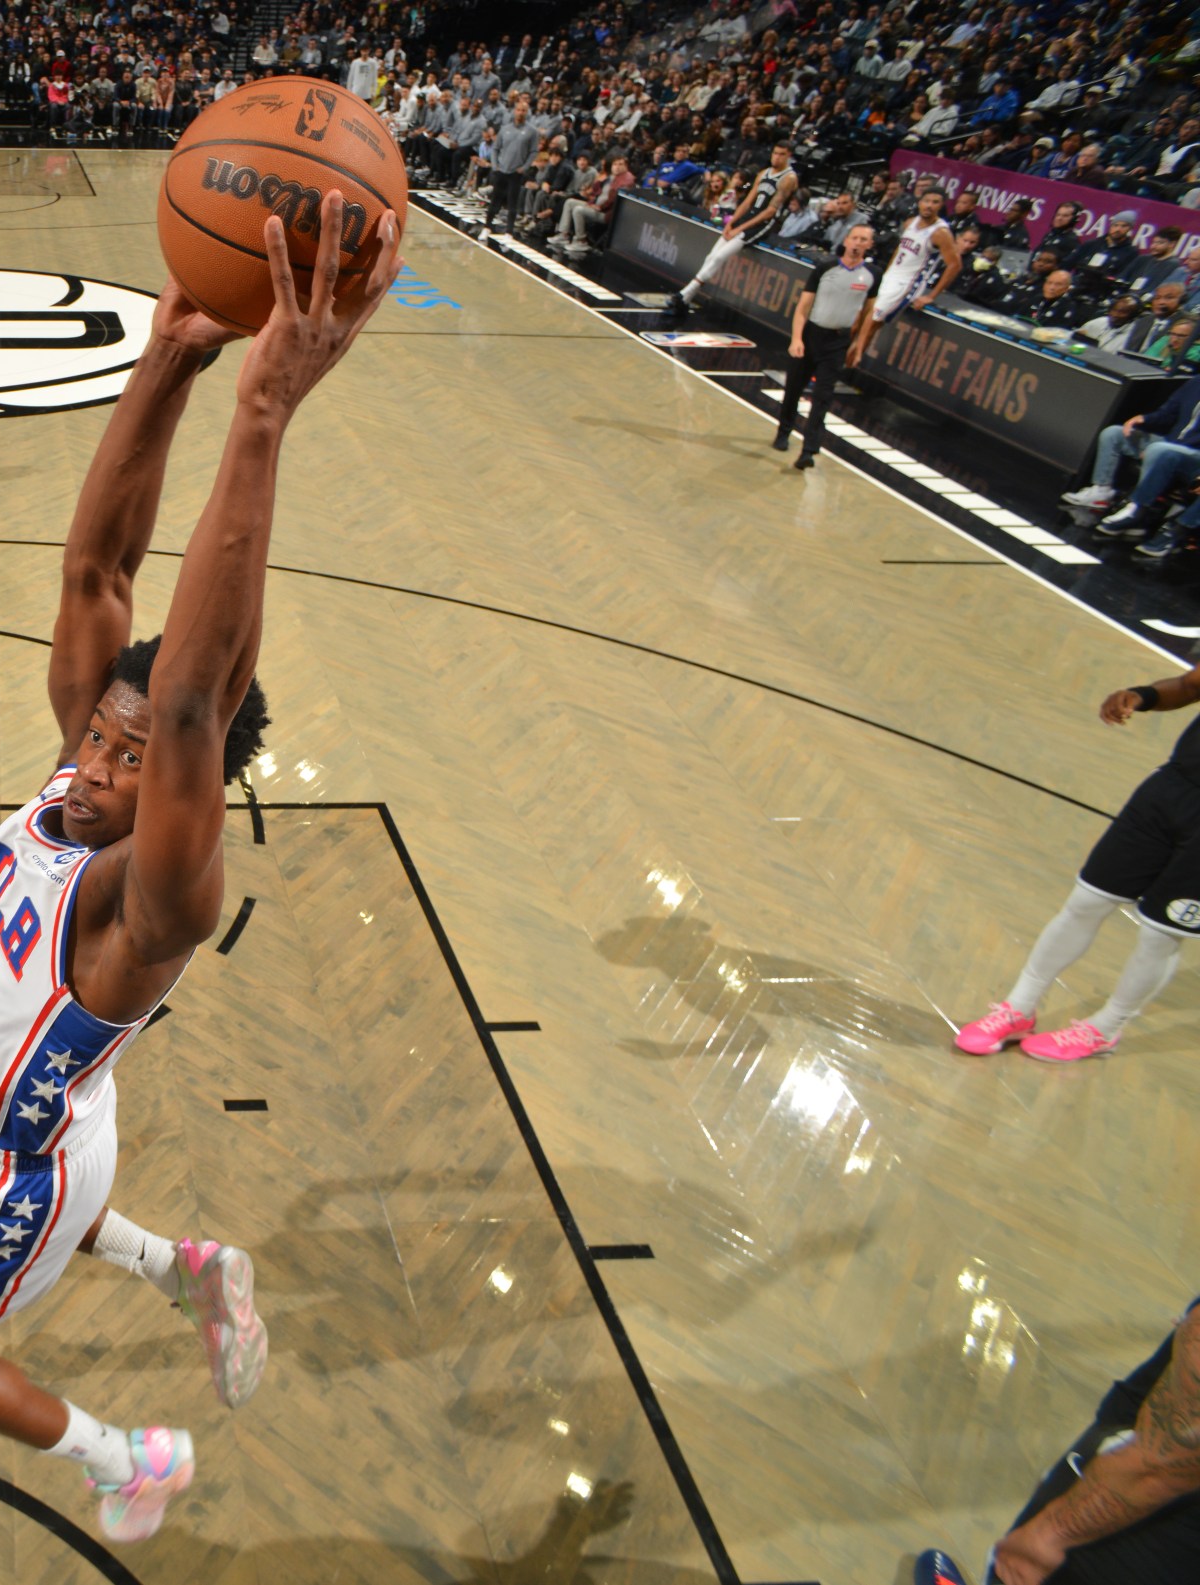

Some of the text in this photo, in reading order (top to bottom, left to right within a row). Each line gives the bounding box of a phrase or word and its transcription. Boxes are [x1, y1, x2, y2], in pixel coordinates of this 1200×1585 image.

[202, 156, 367, 256] Wilson
[709, 254, 790, 313] REWED
[886, 320, 1038, 423] TIME FANS
[31, 854, 66, 887] crypto.com
